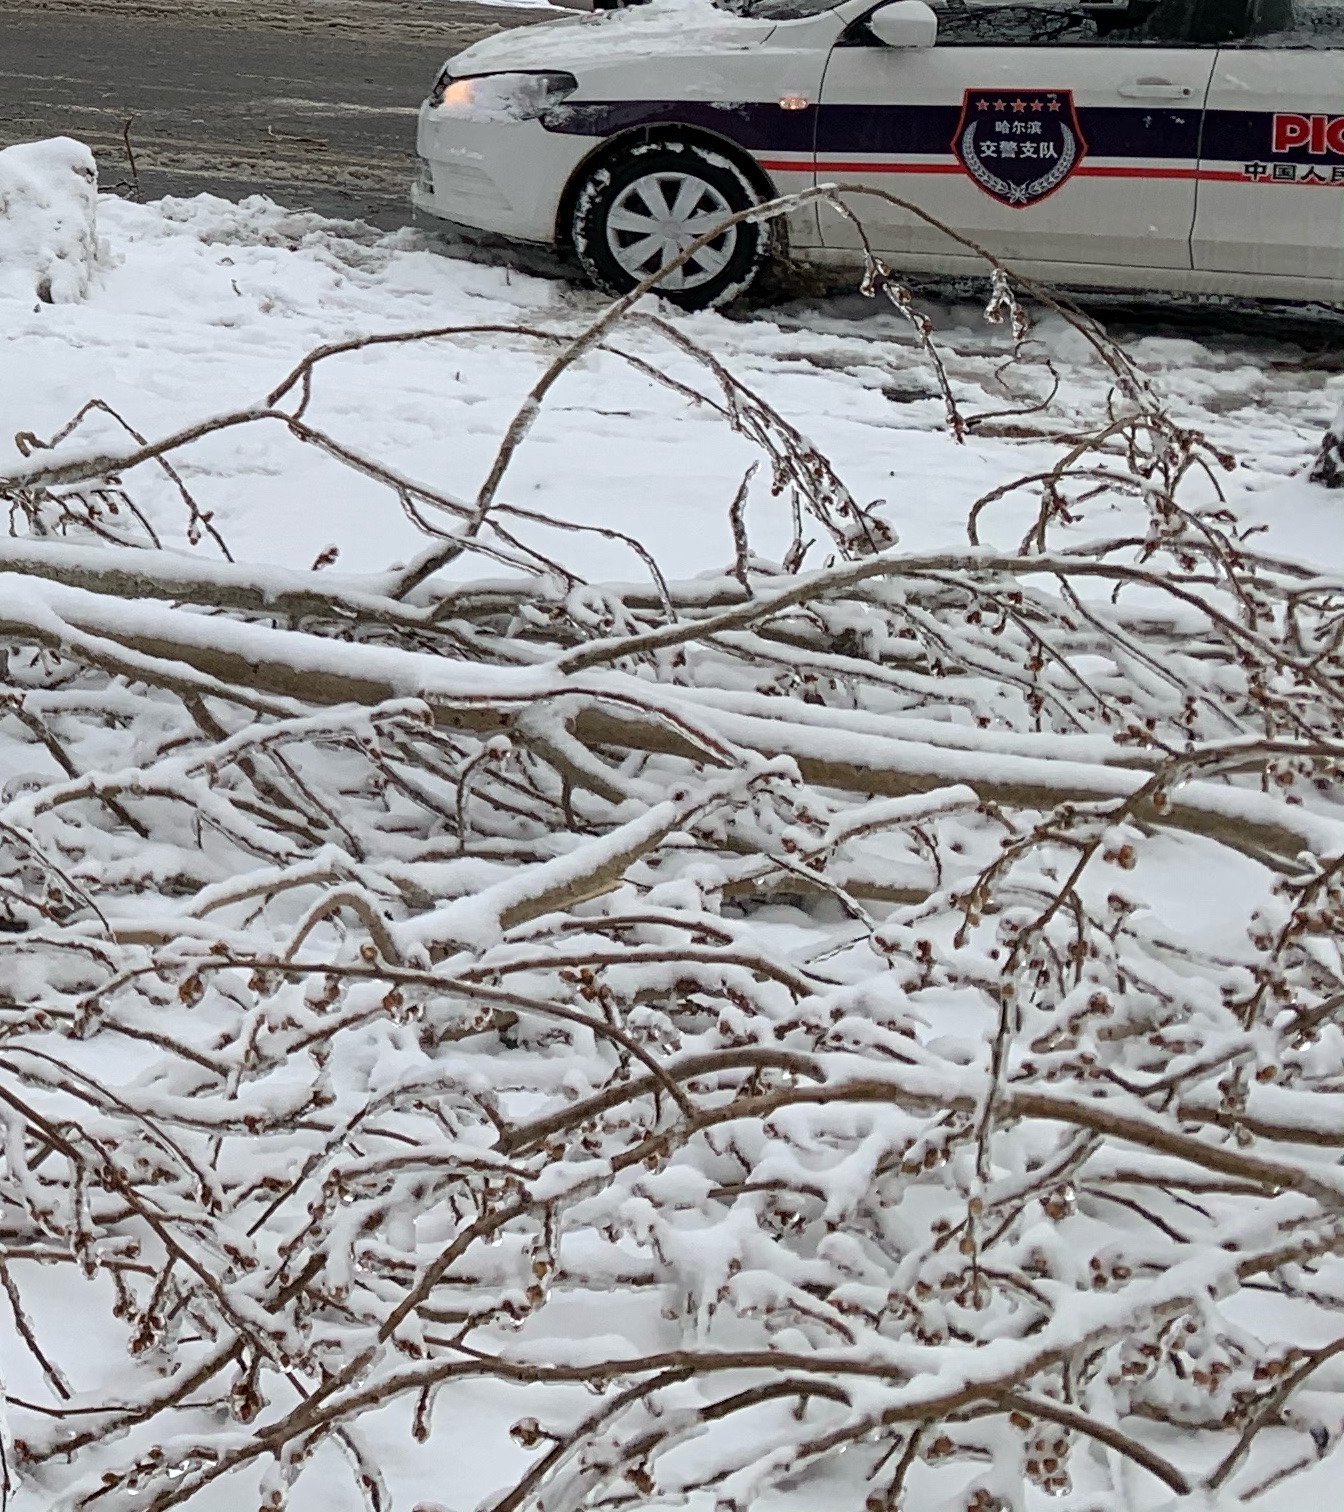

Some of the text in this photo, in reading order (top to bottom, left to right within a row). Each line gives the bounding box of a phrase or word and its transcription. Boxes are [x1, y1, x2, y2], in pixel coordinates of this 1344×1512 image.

[995, 120, 1043, 135] 哈尔滨
[979, 140, 1059, 159] 交警支队
